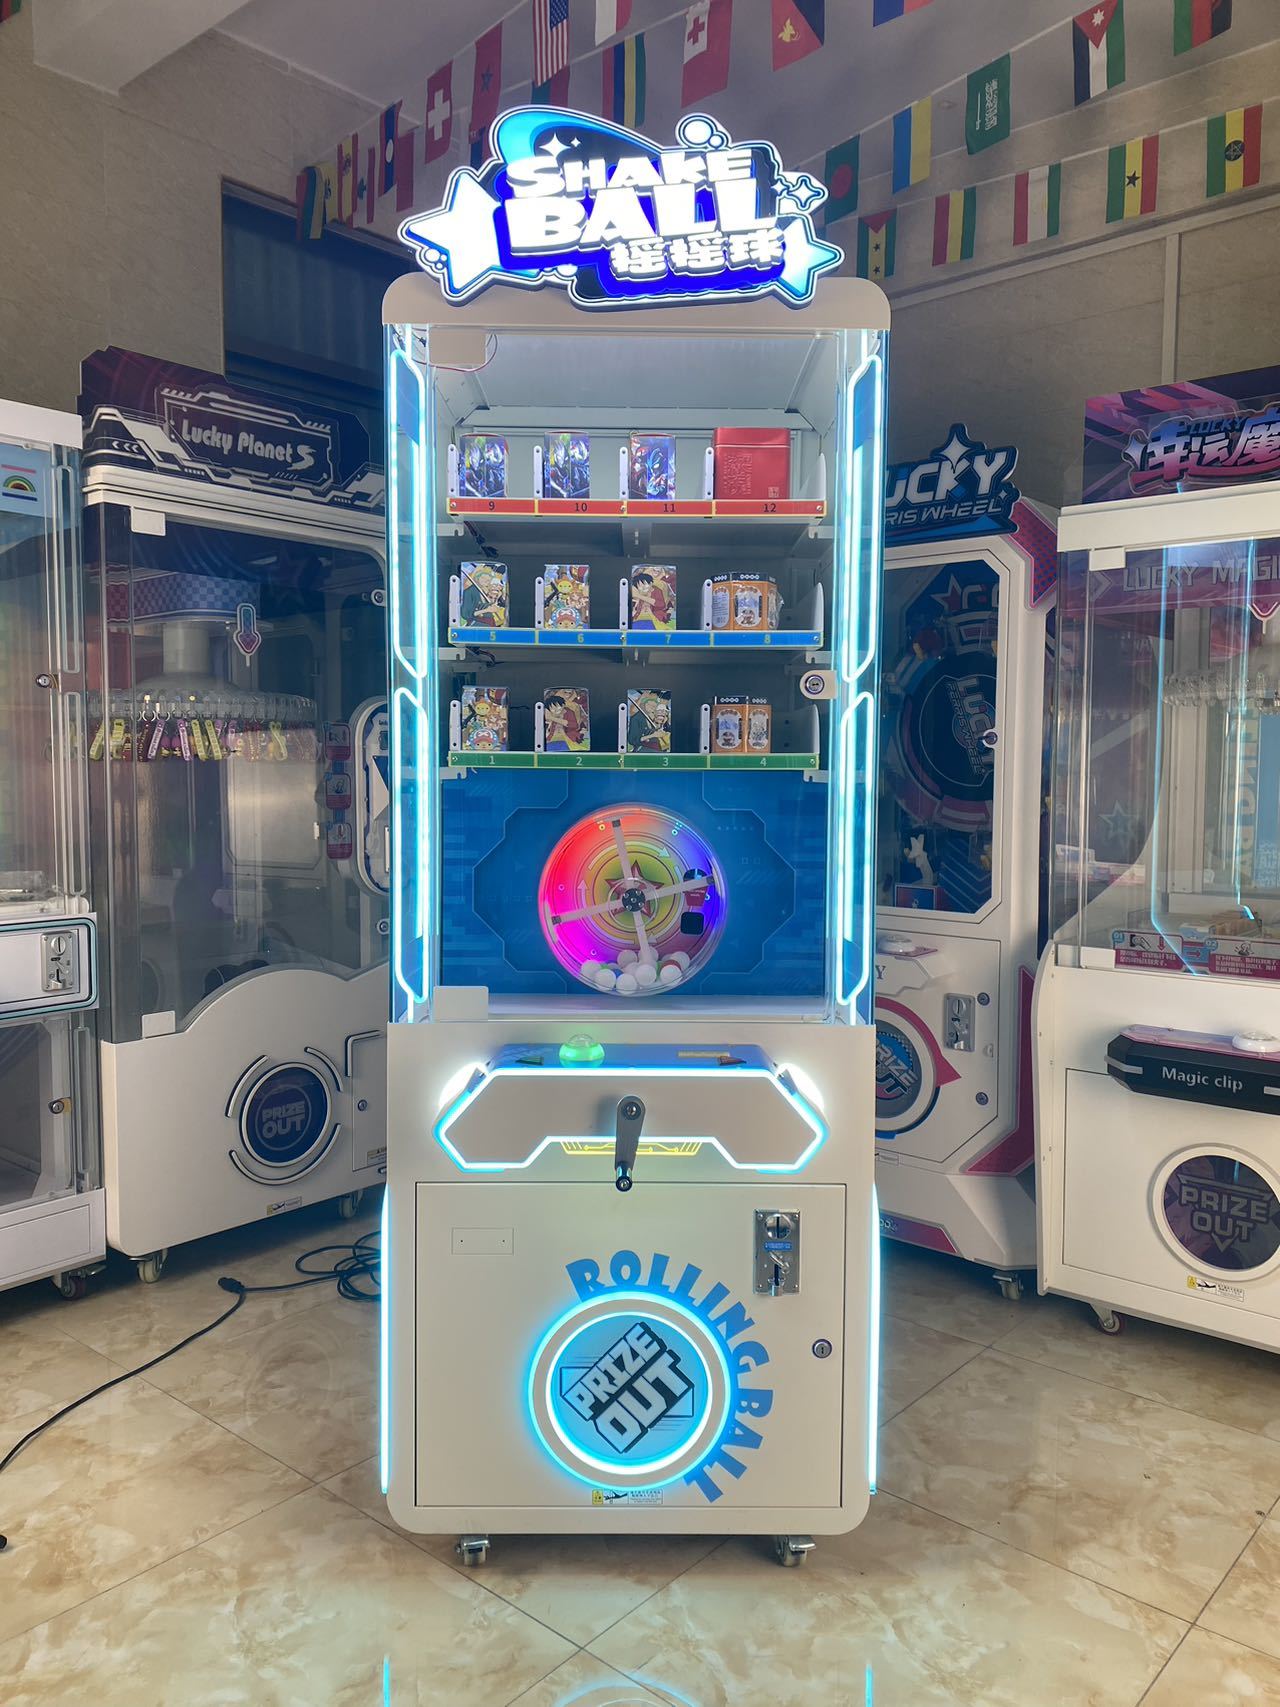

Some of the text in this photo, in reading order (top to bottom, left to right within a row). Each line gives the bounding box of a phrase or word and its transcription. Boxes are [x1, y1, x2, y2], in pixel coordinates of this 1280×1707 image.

[505, 148, 754, 200] SHAKE
[504, 179, 779, 254] BALL
[608, 229, 786, 281] 摇摇球
[1189, 416, 1244, 434] LUCKY
[181, 419, 233, 455] Lucky
[238, 432, 293, 464] Planet
[488, 501, 496, 512] 9
[574, 502, 588, 512] 10
[663, 502, 676, 513] 11
[763, 502, 777, 513] 12
[921, 498, 1002, 522] WHEEL
[1122, 561, 1200, 592] LUCKY
[489, 630, 497, 642] 5
[577, 632, 584, 643] 6
[664, 633, 672, 644] 7
[763, 634, 771, 645] 8
[489, 755, 495, 765] 1
[576, 756, 583, 766] 2
[662, 757, 669, 767] 3
[759, 757, 767, 767] 4
[1161, 1065, 1243, 1093] Magic clip
[262, 1101, 306, 1121] PRIZE
[262, 1116, 306, 1139] OUT
[1179, 1184, 1269, 1223] PRIZE
[1192, 1209, 1256, 1241] OUT
[561, 1322, 667, 1421] PRIZE
[595, 1350, 694, 1453] OUT
